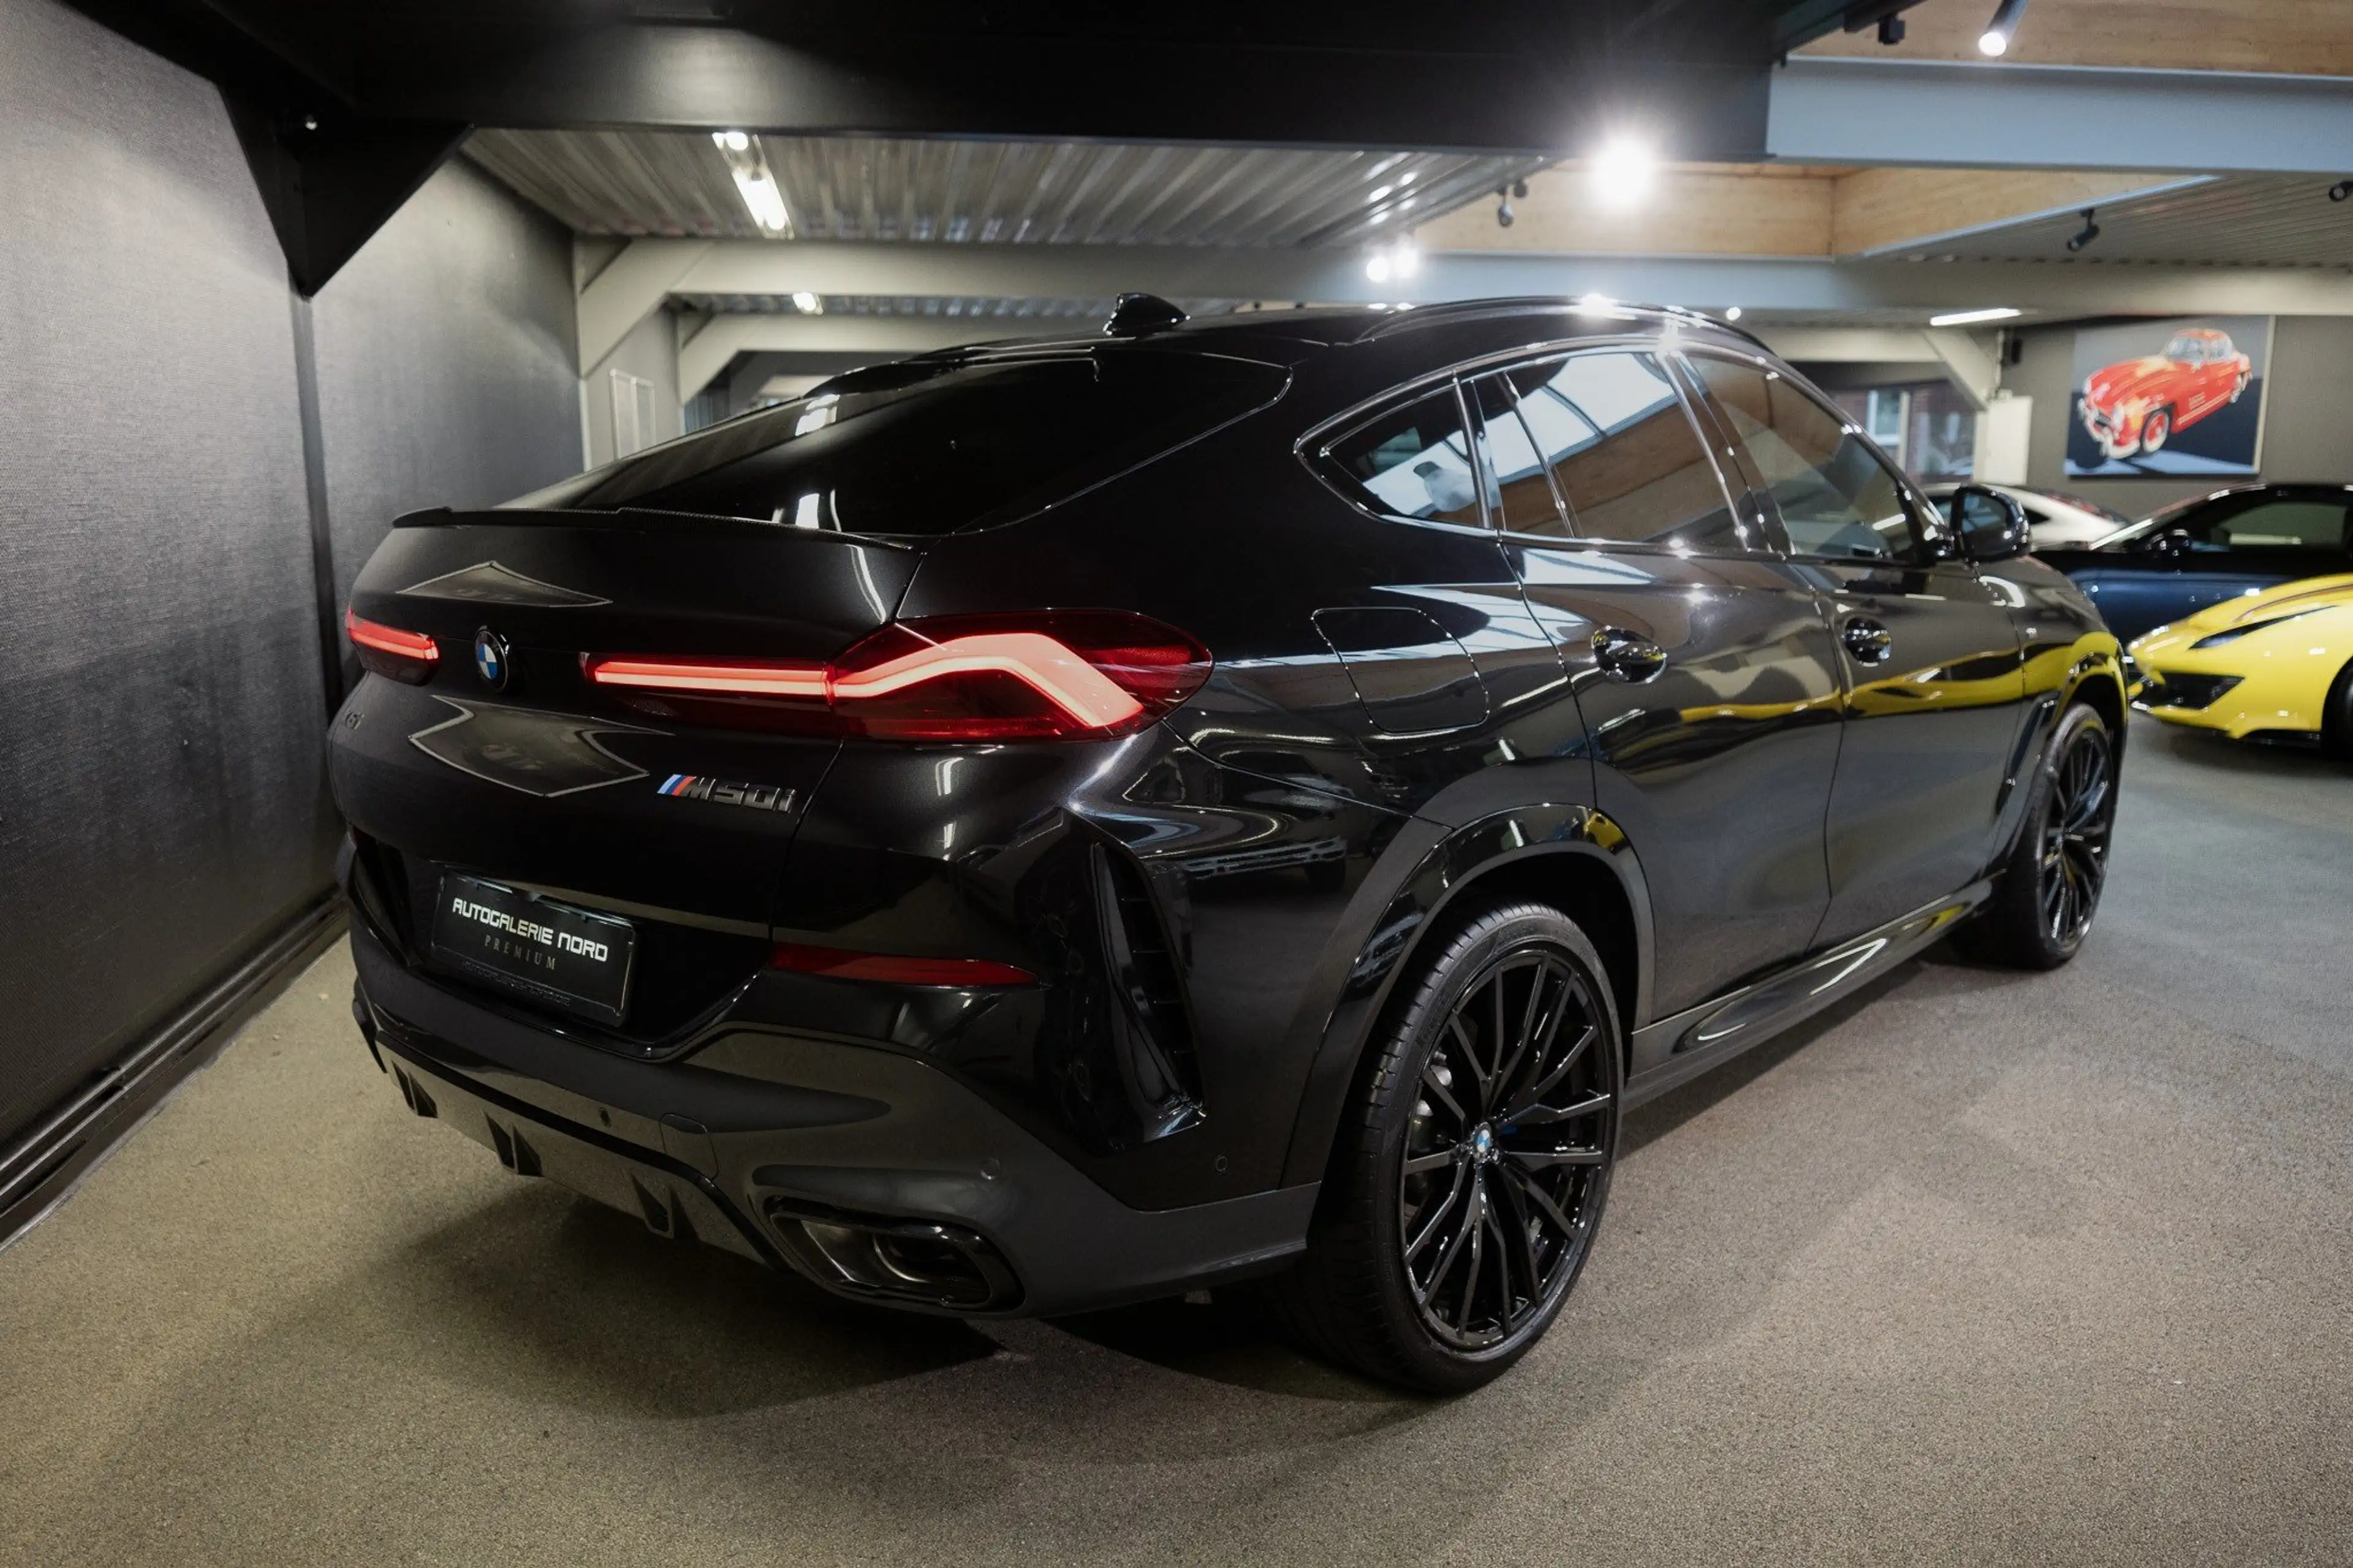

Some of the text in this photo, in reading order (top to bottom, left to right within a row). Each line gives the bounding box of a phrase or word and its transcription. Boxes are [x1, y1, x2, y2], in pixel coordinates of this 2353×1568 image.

[679, 776, 797, 813] M50i
[452, 898, 608, 962] AUTOGALERIE NORD
[485, 935, 556, 970] PREMIUM
